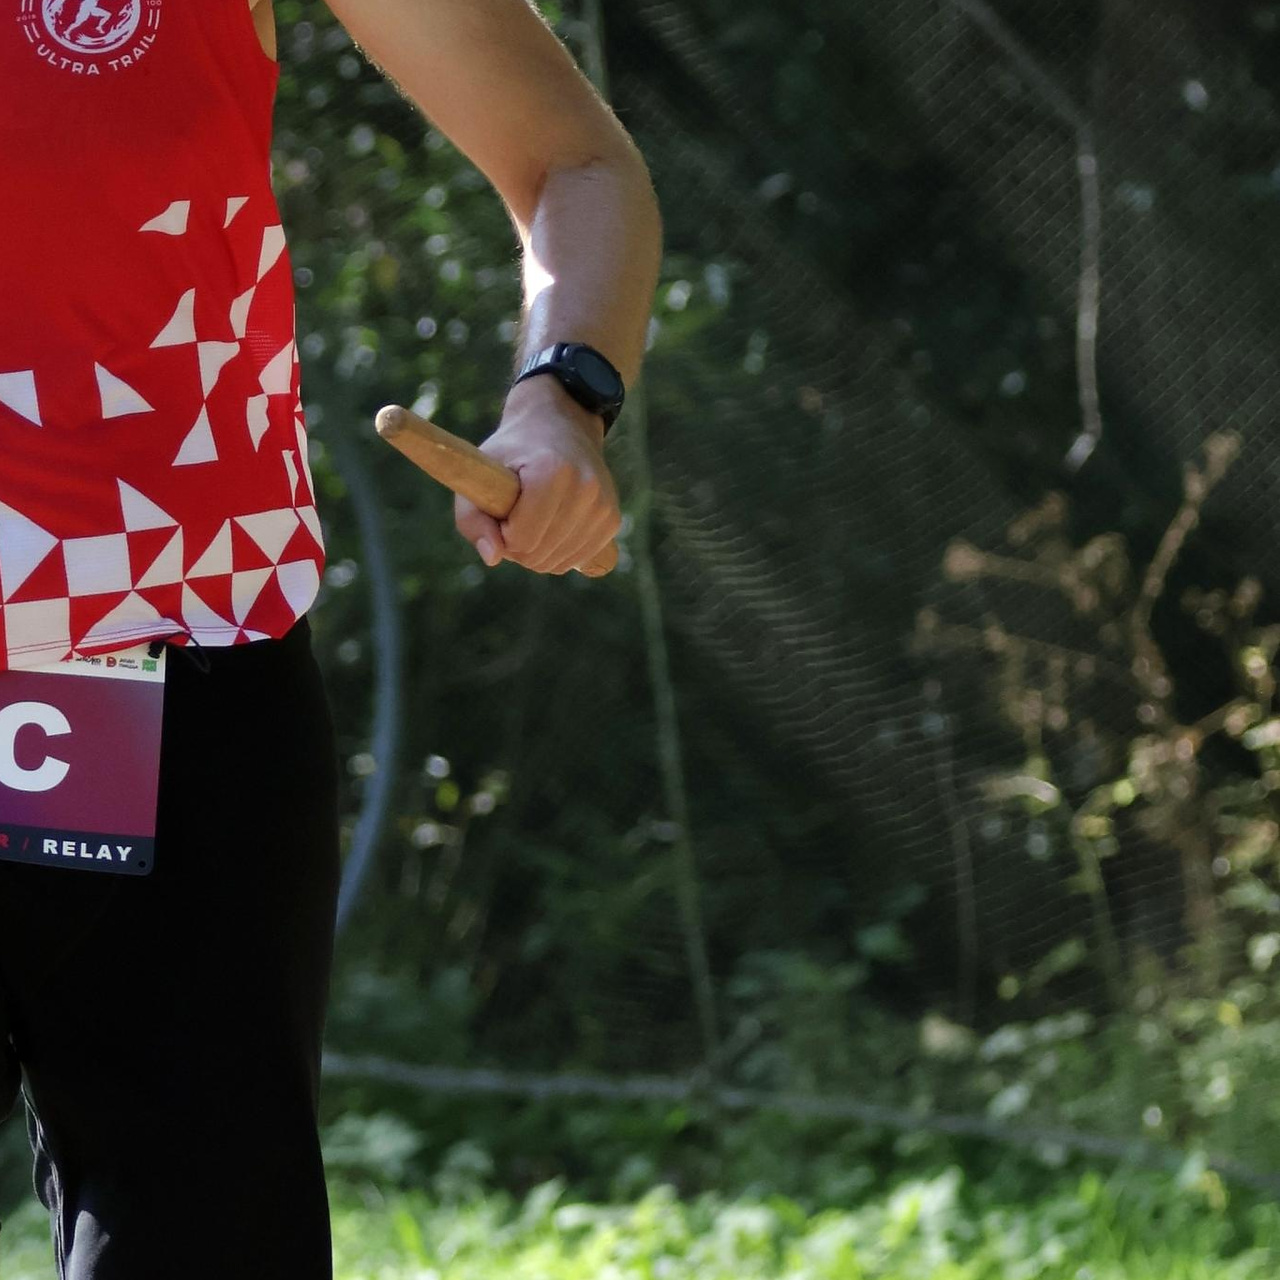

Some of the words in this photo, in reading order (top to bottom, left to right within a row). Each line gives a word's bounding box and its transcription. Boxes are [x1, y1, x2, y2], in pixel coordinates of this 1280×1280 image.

[37, 43, 100, 75] ULTRA
[108, 33, 156, 71] TRAIL
[42, 838, 133, 862] RELAY
